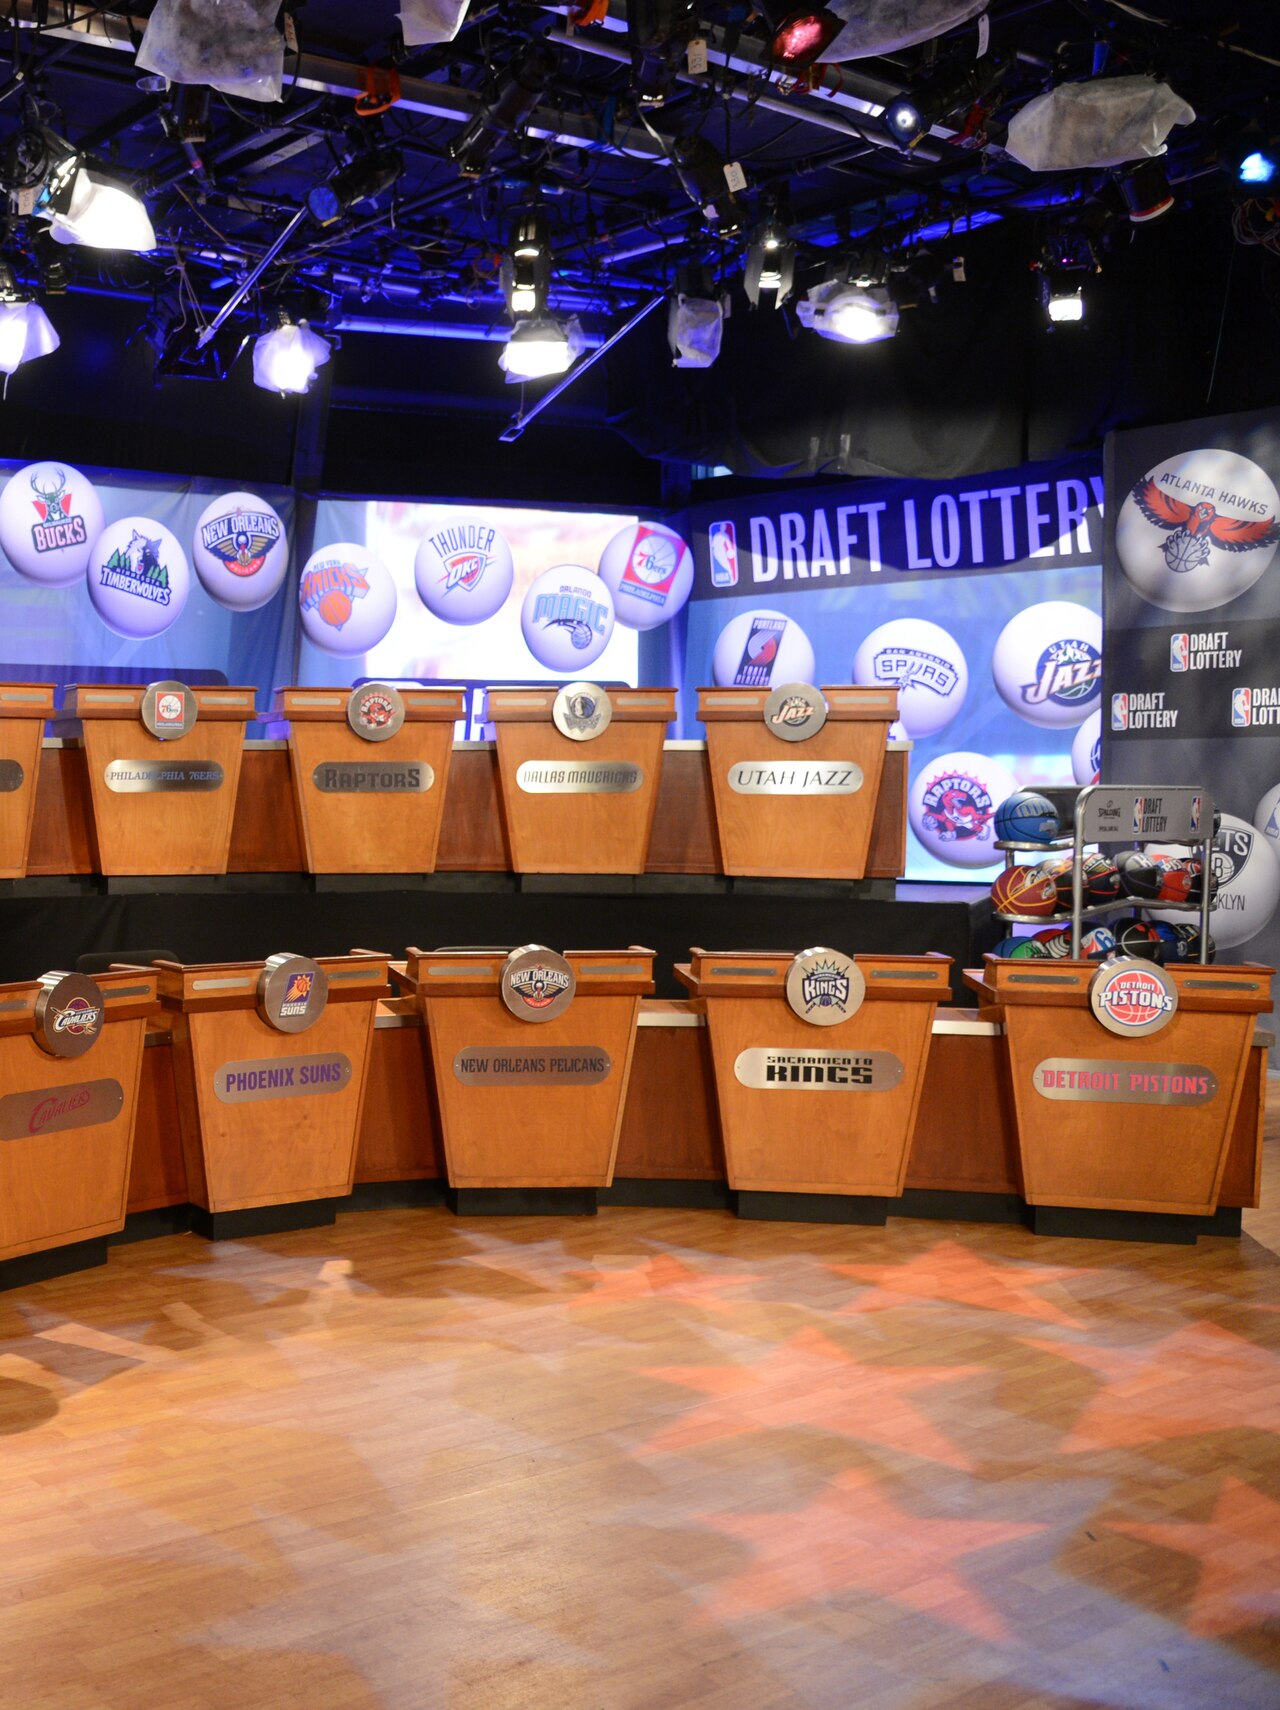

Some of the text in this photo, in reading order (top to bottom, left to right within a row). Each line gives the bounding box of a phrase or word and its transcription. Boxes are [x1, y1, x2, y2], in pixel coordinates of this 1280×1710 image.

[1160, 472, 1269, 516] ATLANTA HAWKS
[33, 517, 86, 551] BUCKS
[203, 516, 280, 547] NEW ORLEANS
[428, 525, 496, 558] THUNDER
[749, 502, 886, 582] DRAFT
[101, 567, 170, 605] TIMBERWOLVES
[532, 593, 609, 636] MAGIC
[1048, 640, 1089, 654] UTAH
[1190, 632, 1228, 651] DRAFT
[1190, 650, 1242, 670] LOTTERY
[882, 659, 950, 687] SPURS
[1129, 692, 1165, 710] DRAFT
[1253, 688, 1280, 706] DRA
[772, 705, 815, 724] JAZZ
[1129, 710, 1178, 729] LOTTERY
[189, 770, 219, 780] 76ERS
[325, 768, 420, 788] RAPTORS
[523, 770, 638, 783] DALLAS MAVERICKS
[738, 770, 853, 788] UTAH JAZZ
[923, 777, 991, 808] RAPTORS
[1143, 798, 1162, 815] DRAFT
[1142, 816, 1167, 833] LOTTERY
[510, 970, 569, 987] NEW ORLEANS
[1120, 981, 1155, 991] DETROIT
[804, 978, 848, 1000] KINGS
[280, 1005, 307, 1016] SUNS
[1098, 991, 1173, 1011] PISTONS
[461, 1058, 604, 1072] NEW ORLEANS PELICANS
[767, 1056, 873, 1066] SACRAMENTO
[226, 1063, 341, 1093] PHOENIX SUNS
[767, 1065, 873, 1084] KINGS
[1041, 1070, 1209, 1094] DETROIT PISTONS
